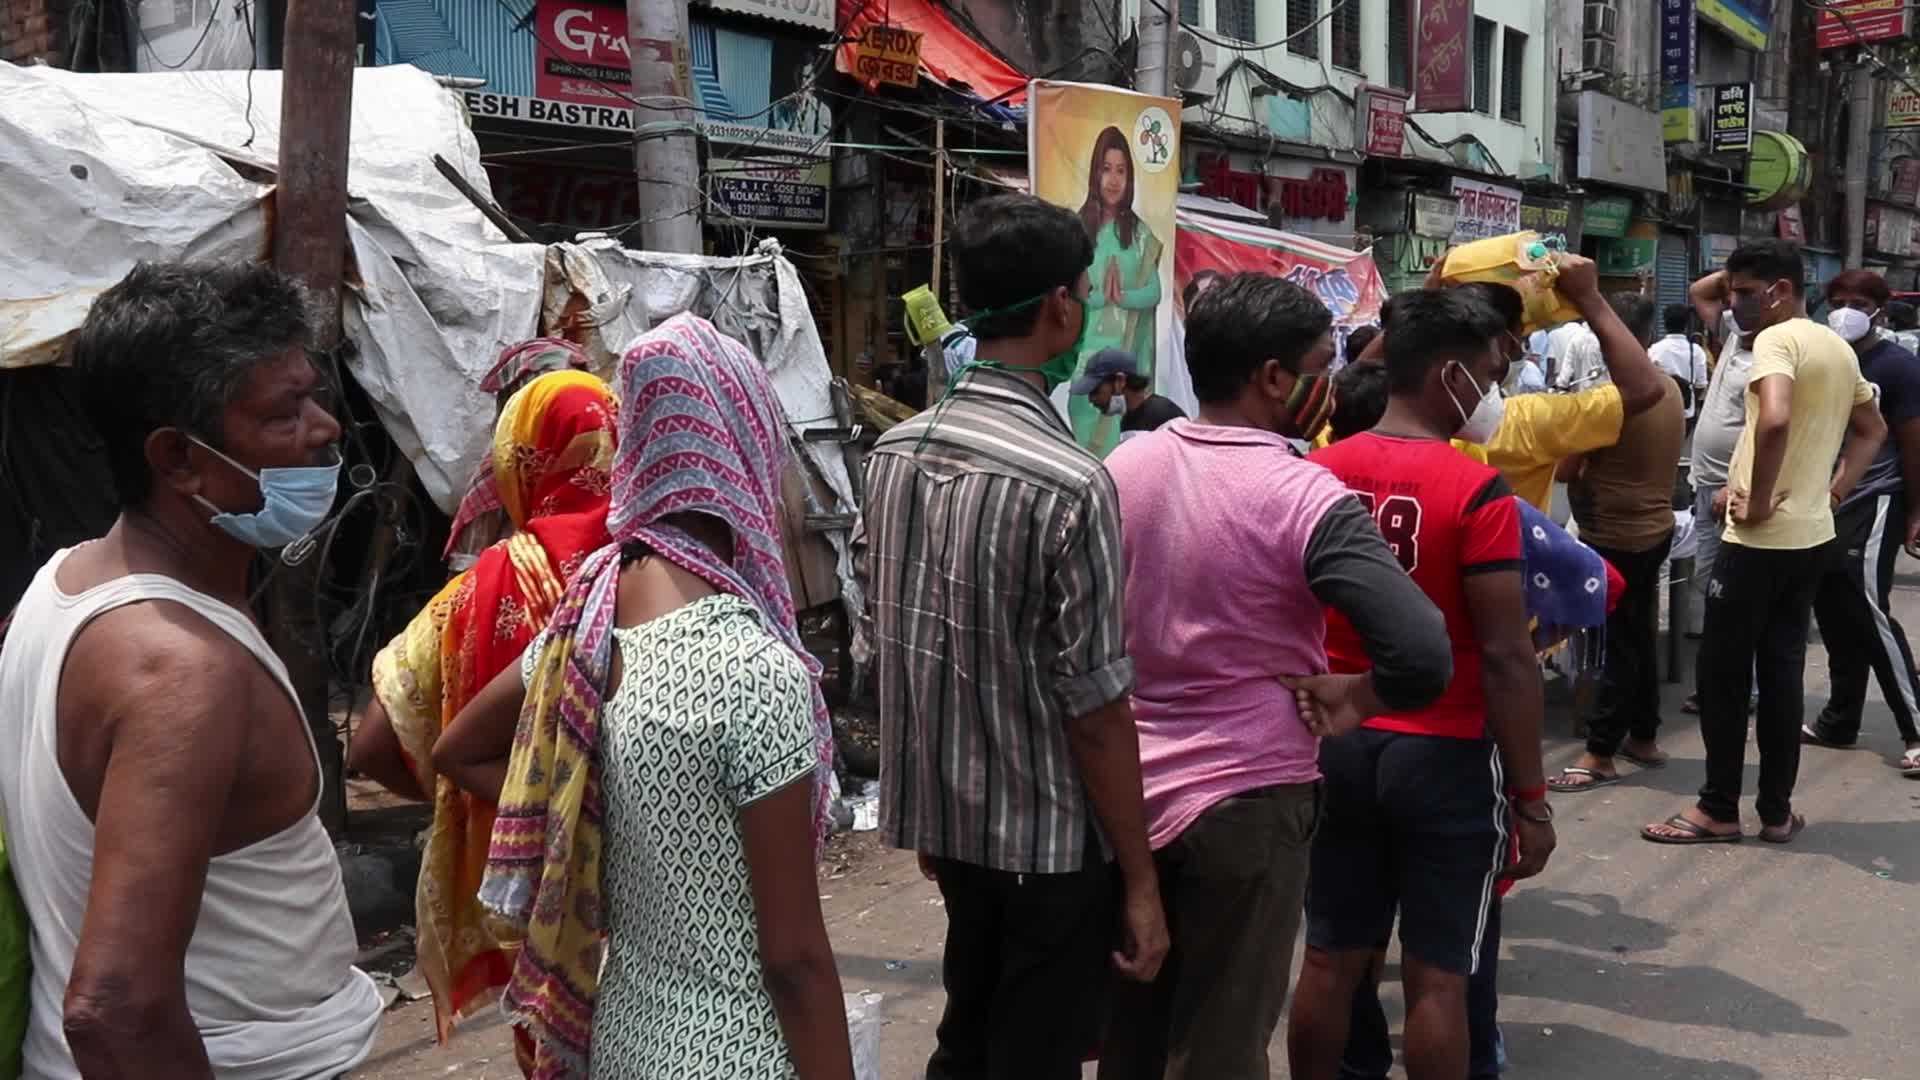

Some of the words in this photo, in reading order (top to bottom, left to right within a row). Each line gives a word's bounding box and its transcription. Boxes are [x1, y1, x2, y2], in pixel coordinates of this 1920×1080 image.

[859, 25, 924, 57] XEROX
[529, 97, 636, 129] BASTRA
[730, 191, 770, 202] KOLKATA
